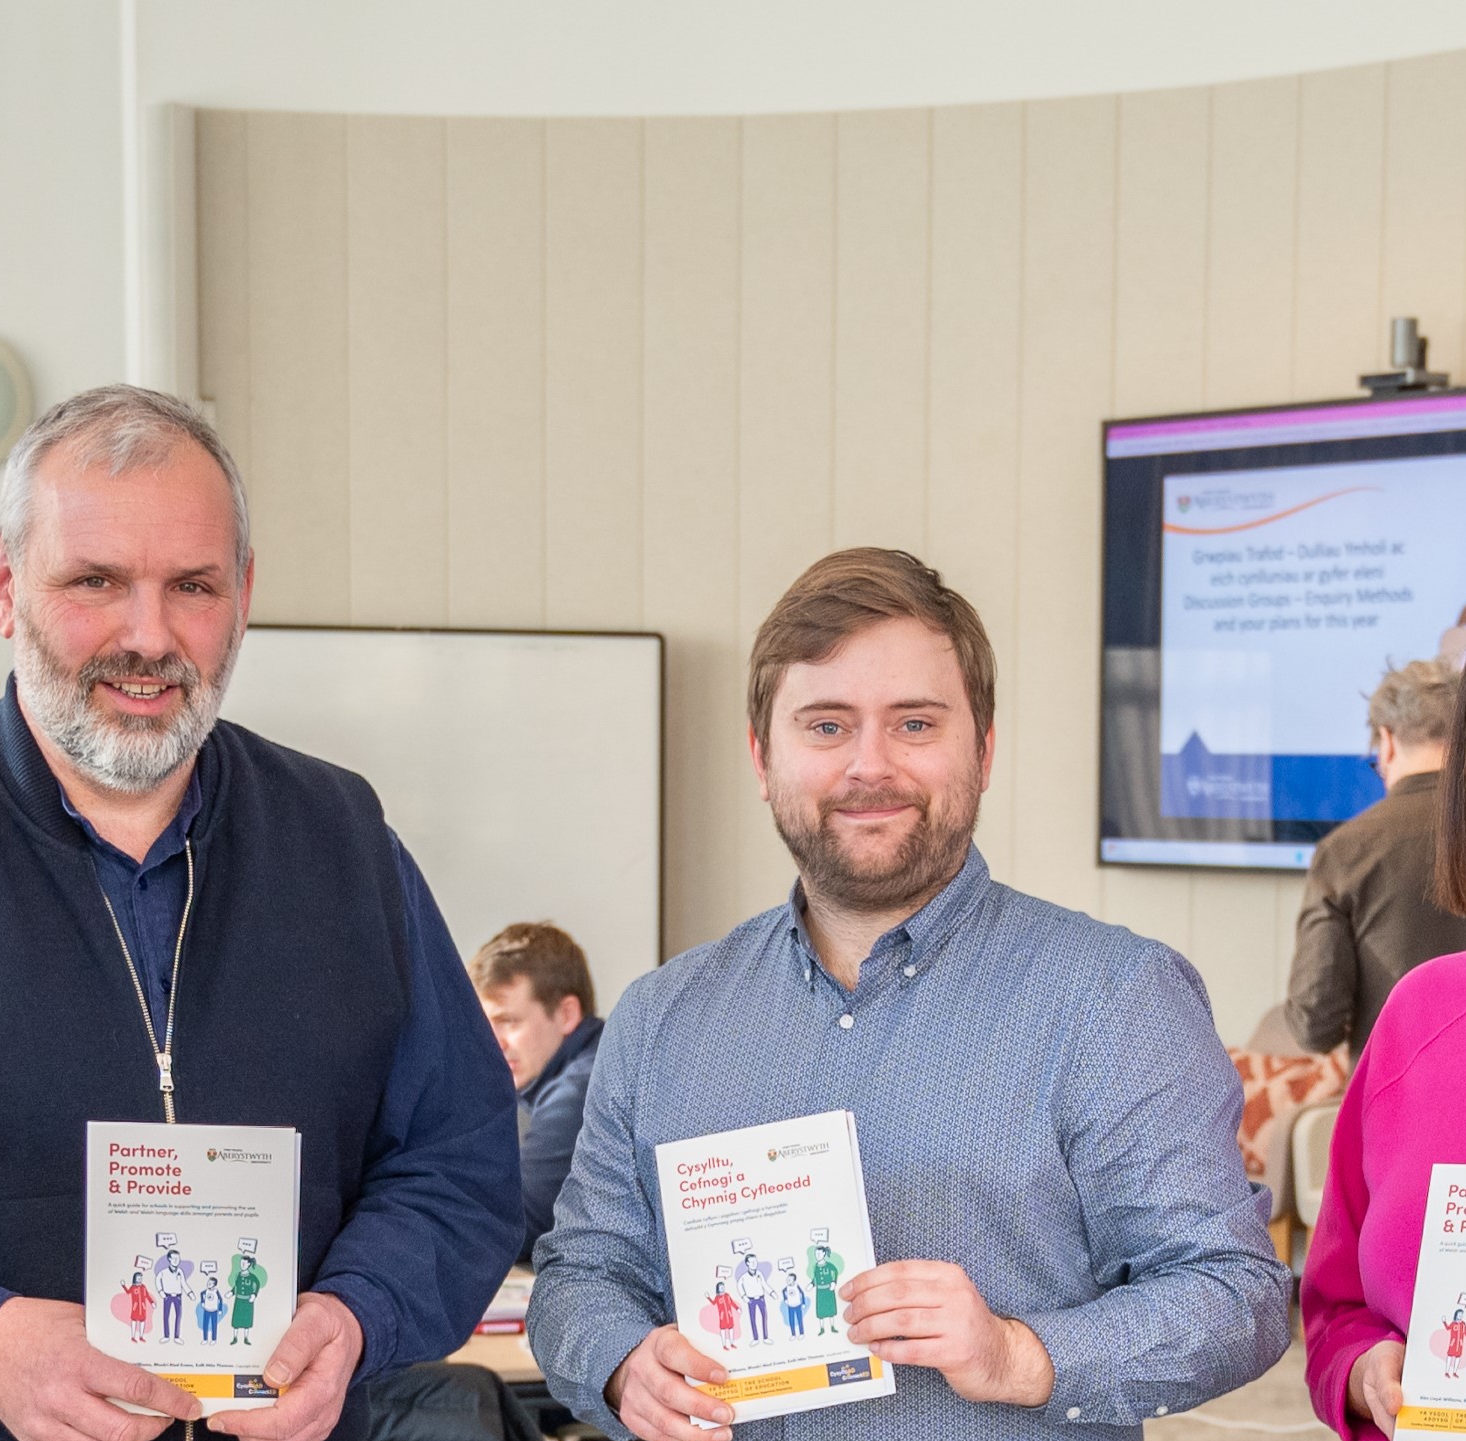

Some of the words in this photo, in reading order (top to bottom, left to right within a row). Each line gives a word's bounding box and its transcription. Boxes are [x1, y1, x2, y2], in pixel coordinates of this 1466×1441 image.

[1184, 595, 1244, 610] Discussion
[1248, 593, 1290, 608] Groups
[1356, 587, 1413, 602] Methods
[1214, 618, 1235, 631] and
[1239, 619, 1265, 632] your
[1270, 616, 1300, 632] plans
[1305, 615, 1321, 628] for
[1325, 614, 1347, 627] this
[1351, 615, 1378, 629] year
[109, 1143, 178, 1161] Partner,
[109, 1161, 182, 1177] Promote
[677, 1157, 733, 1176] Cysylltu,
[108, 1180, 121, 1194] &
[127, 1180, 192, 1195] Provide
[680, 1172, 732, 1192] Cefnogi
[736, 1173, 745, 1182] a
[681, 1190, 737, 1210] Chynnig
[741, 1175, 811, 1200] Cyfleoedd
[1443, 1219, 1454, 1233] &
